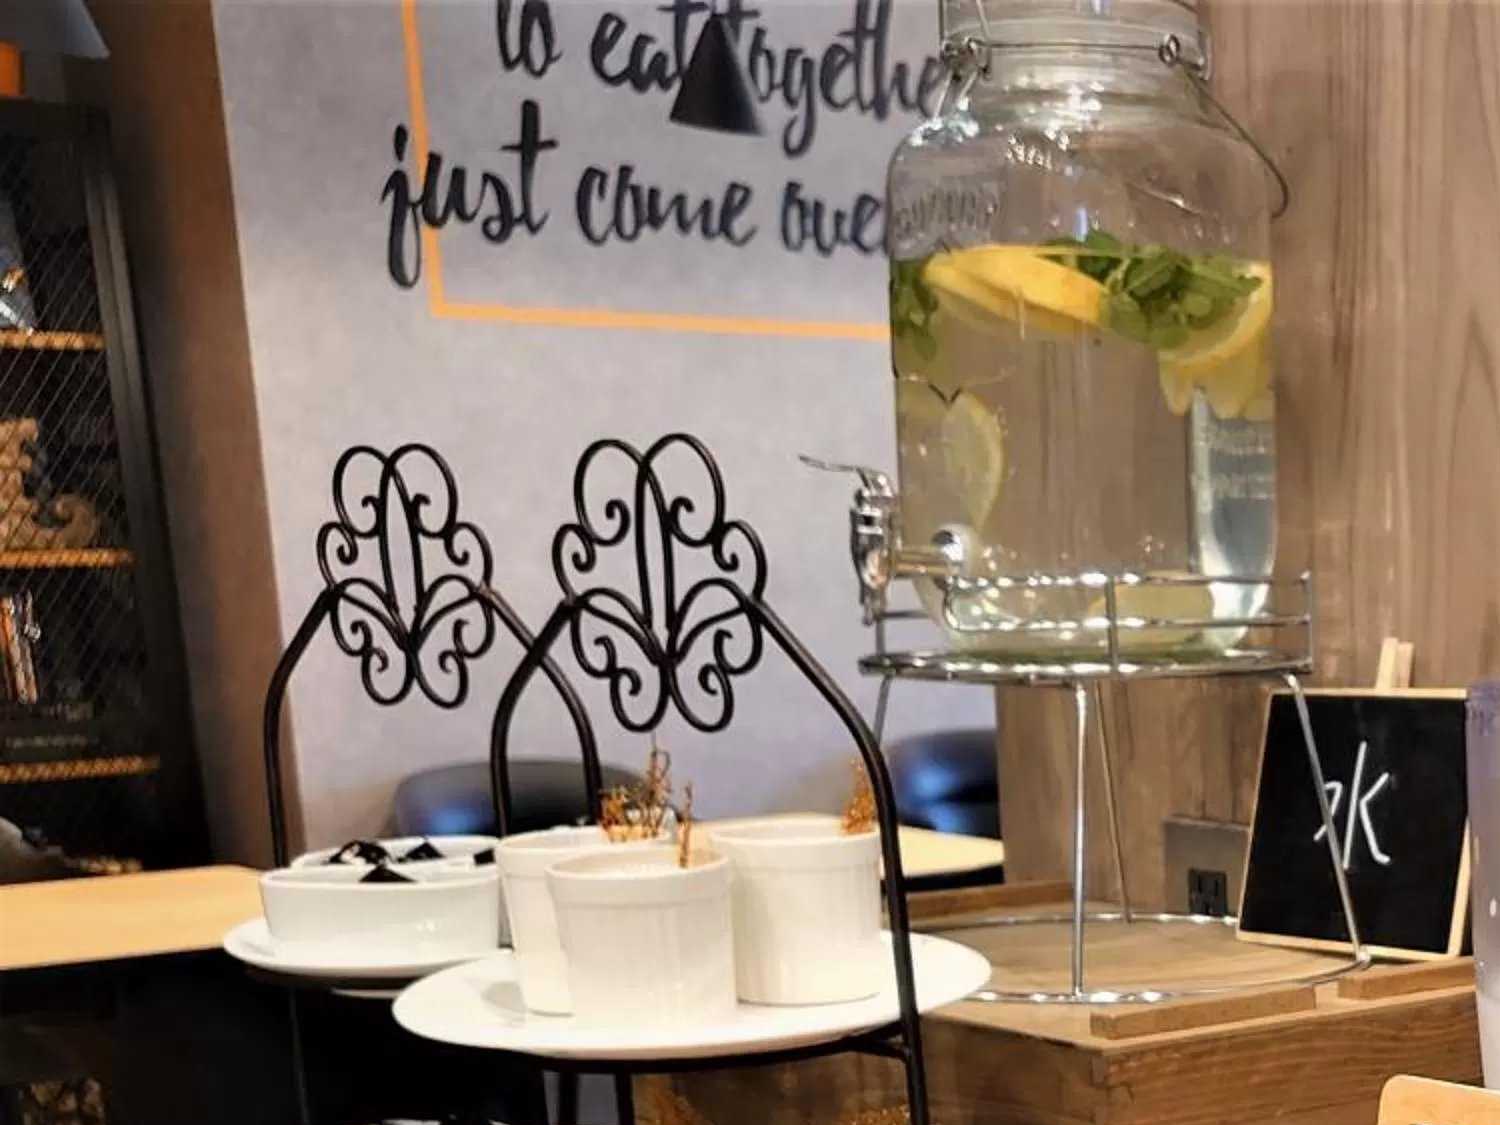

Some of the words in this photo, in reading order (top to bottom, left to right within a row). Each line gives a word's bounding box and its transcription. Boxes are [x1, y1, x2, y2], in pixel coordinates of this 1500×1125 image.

[590, 0, 708, 94] eat
[380, 99, 558, 290] just
[576, 164, 758, 247] come
[781, 181, 890, 257] ove
[1313, 740, 1392, 872] 水
